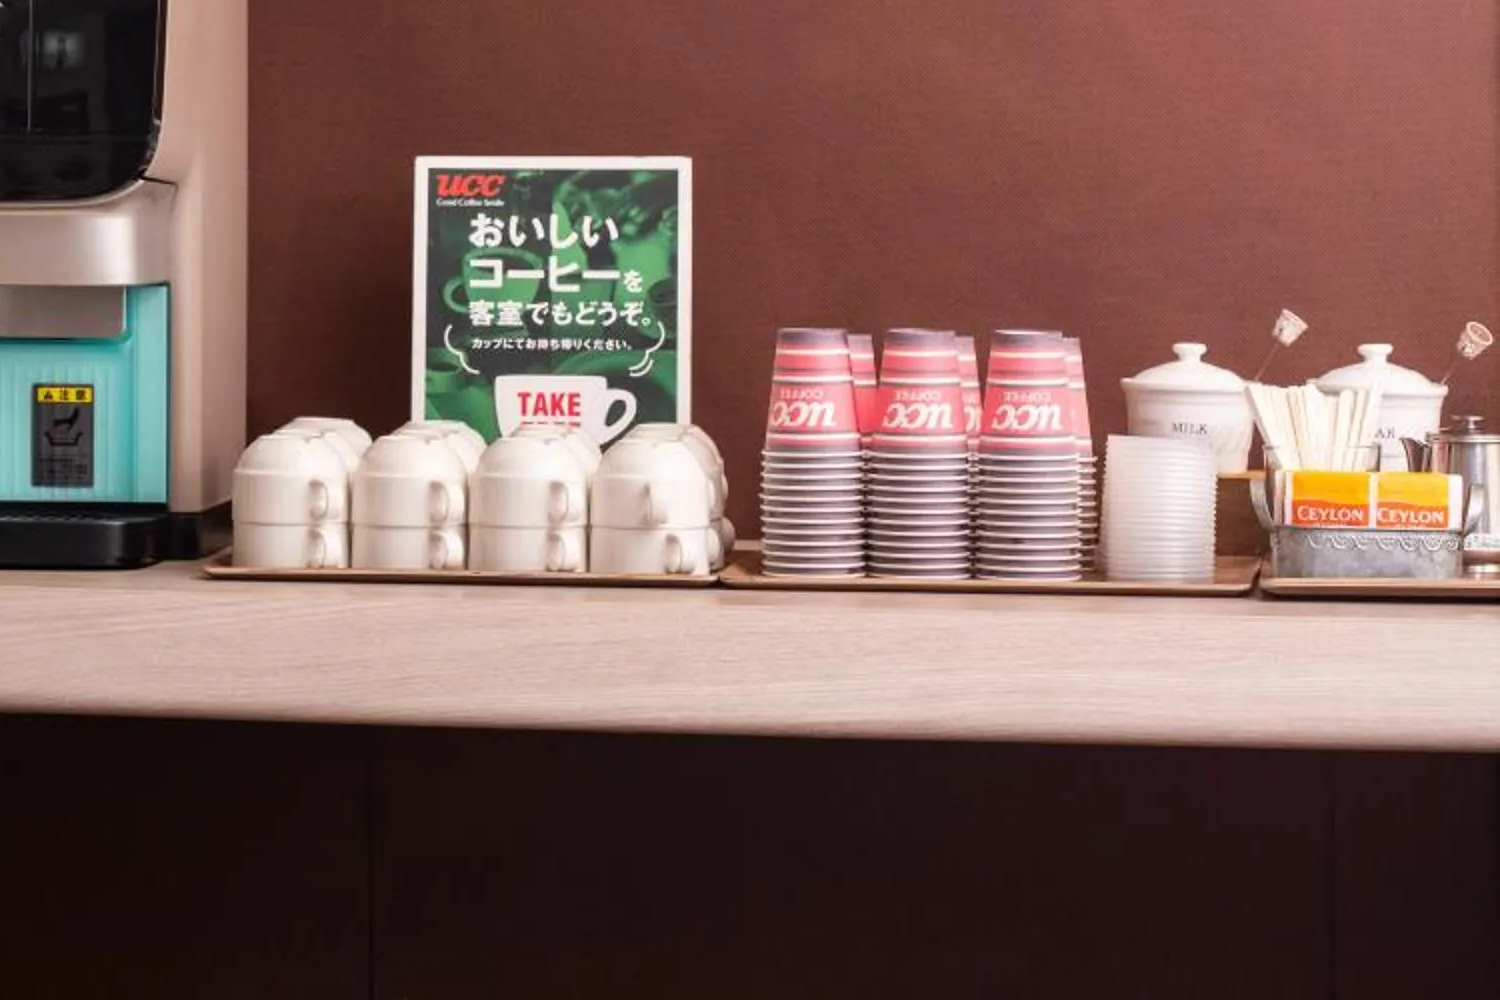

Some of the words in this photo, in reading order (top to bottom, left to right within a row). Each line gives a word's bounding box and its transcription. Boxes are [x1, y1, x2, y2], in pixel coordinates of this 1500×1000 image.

[469, 213, 619, 249] おいしい
[469, 255, 643, 293] コーヒーを
[469, 300, 651, 327] 客室でもどうぞ。
[517, 391, 582, 417] TAKE
[1172, 422, 1208, 435] MILK
[1297, 504, 1364, 522] CEYLON
[1376, 507, 1445, 524] CEYLON
